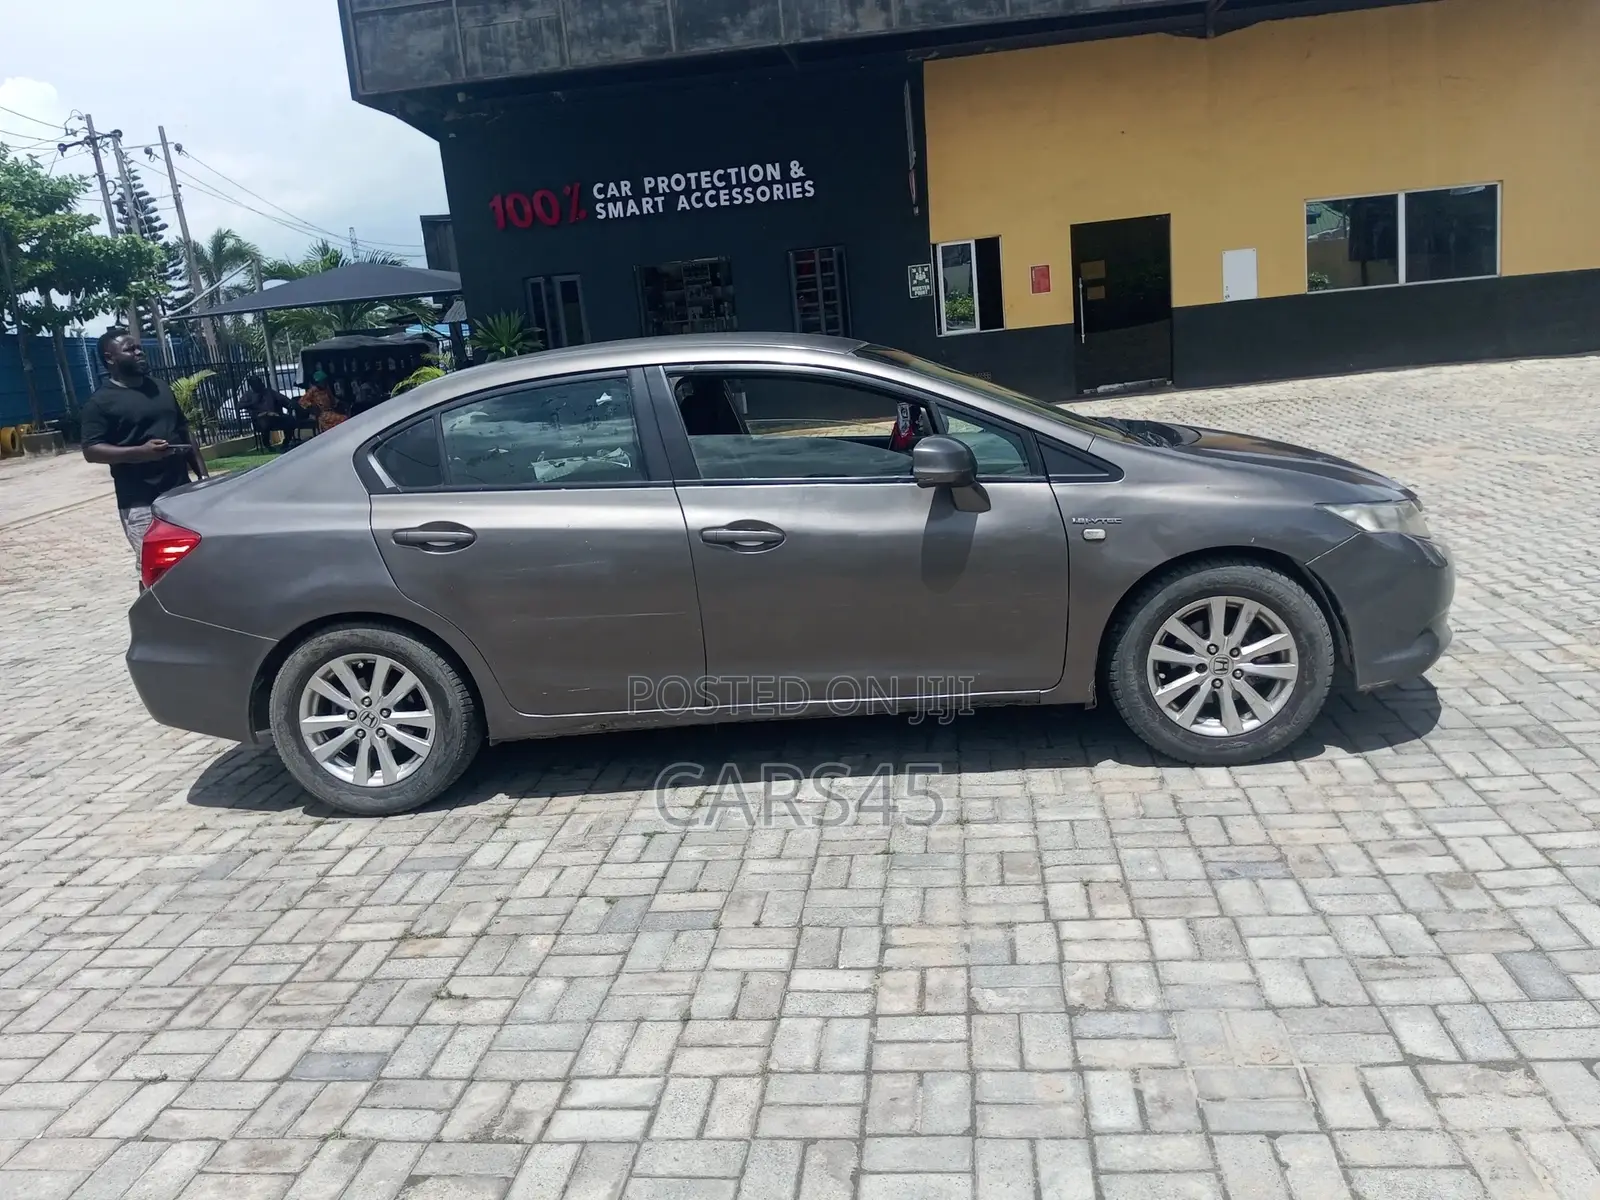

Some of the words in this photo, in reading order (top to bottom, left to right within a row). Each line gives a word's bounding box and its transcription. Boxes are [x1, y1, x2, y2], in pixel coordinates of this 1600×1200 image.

[593, 180, 632, 200] CAR
[643, 163, 781, 195] PROTECTION
[789, 160, 806, 179] &
[595, 196, 665, 220] SMART
[677, 180, 815, 211] ACCESSORIES
[489, 182, 588, 231] 100%
